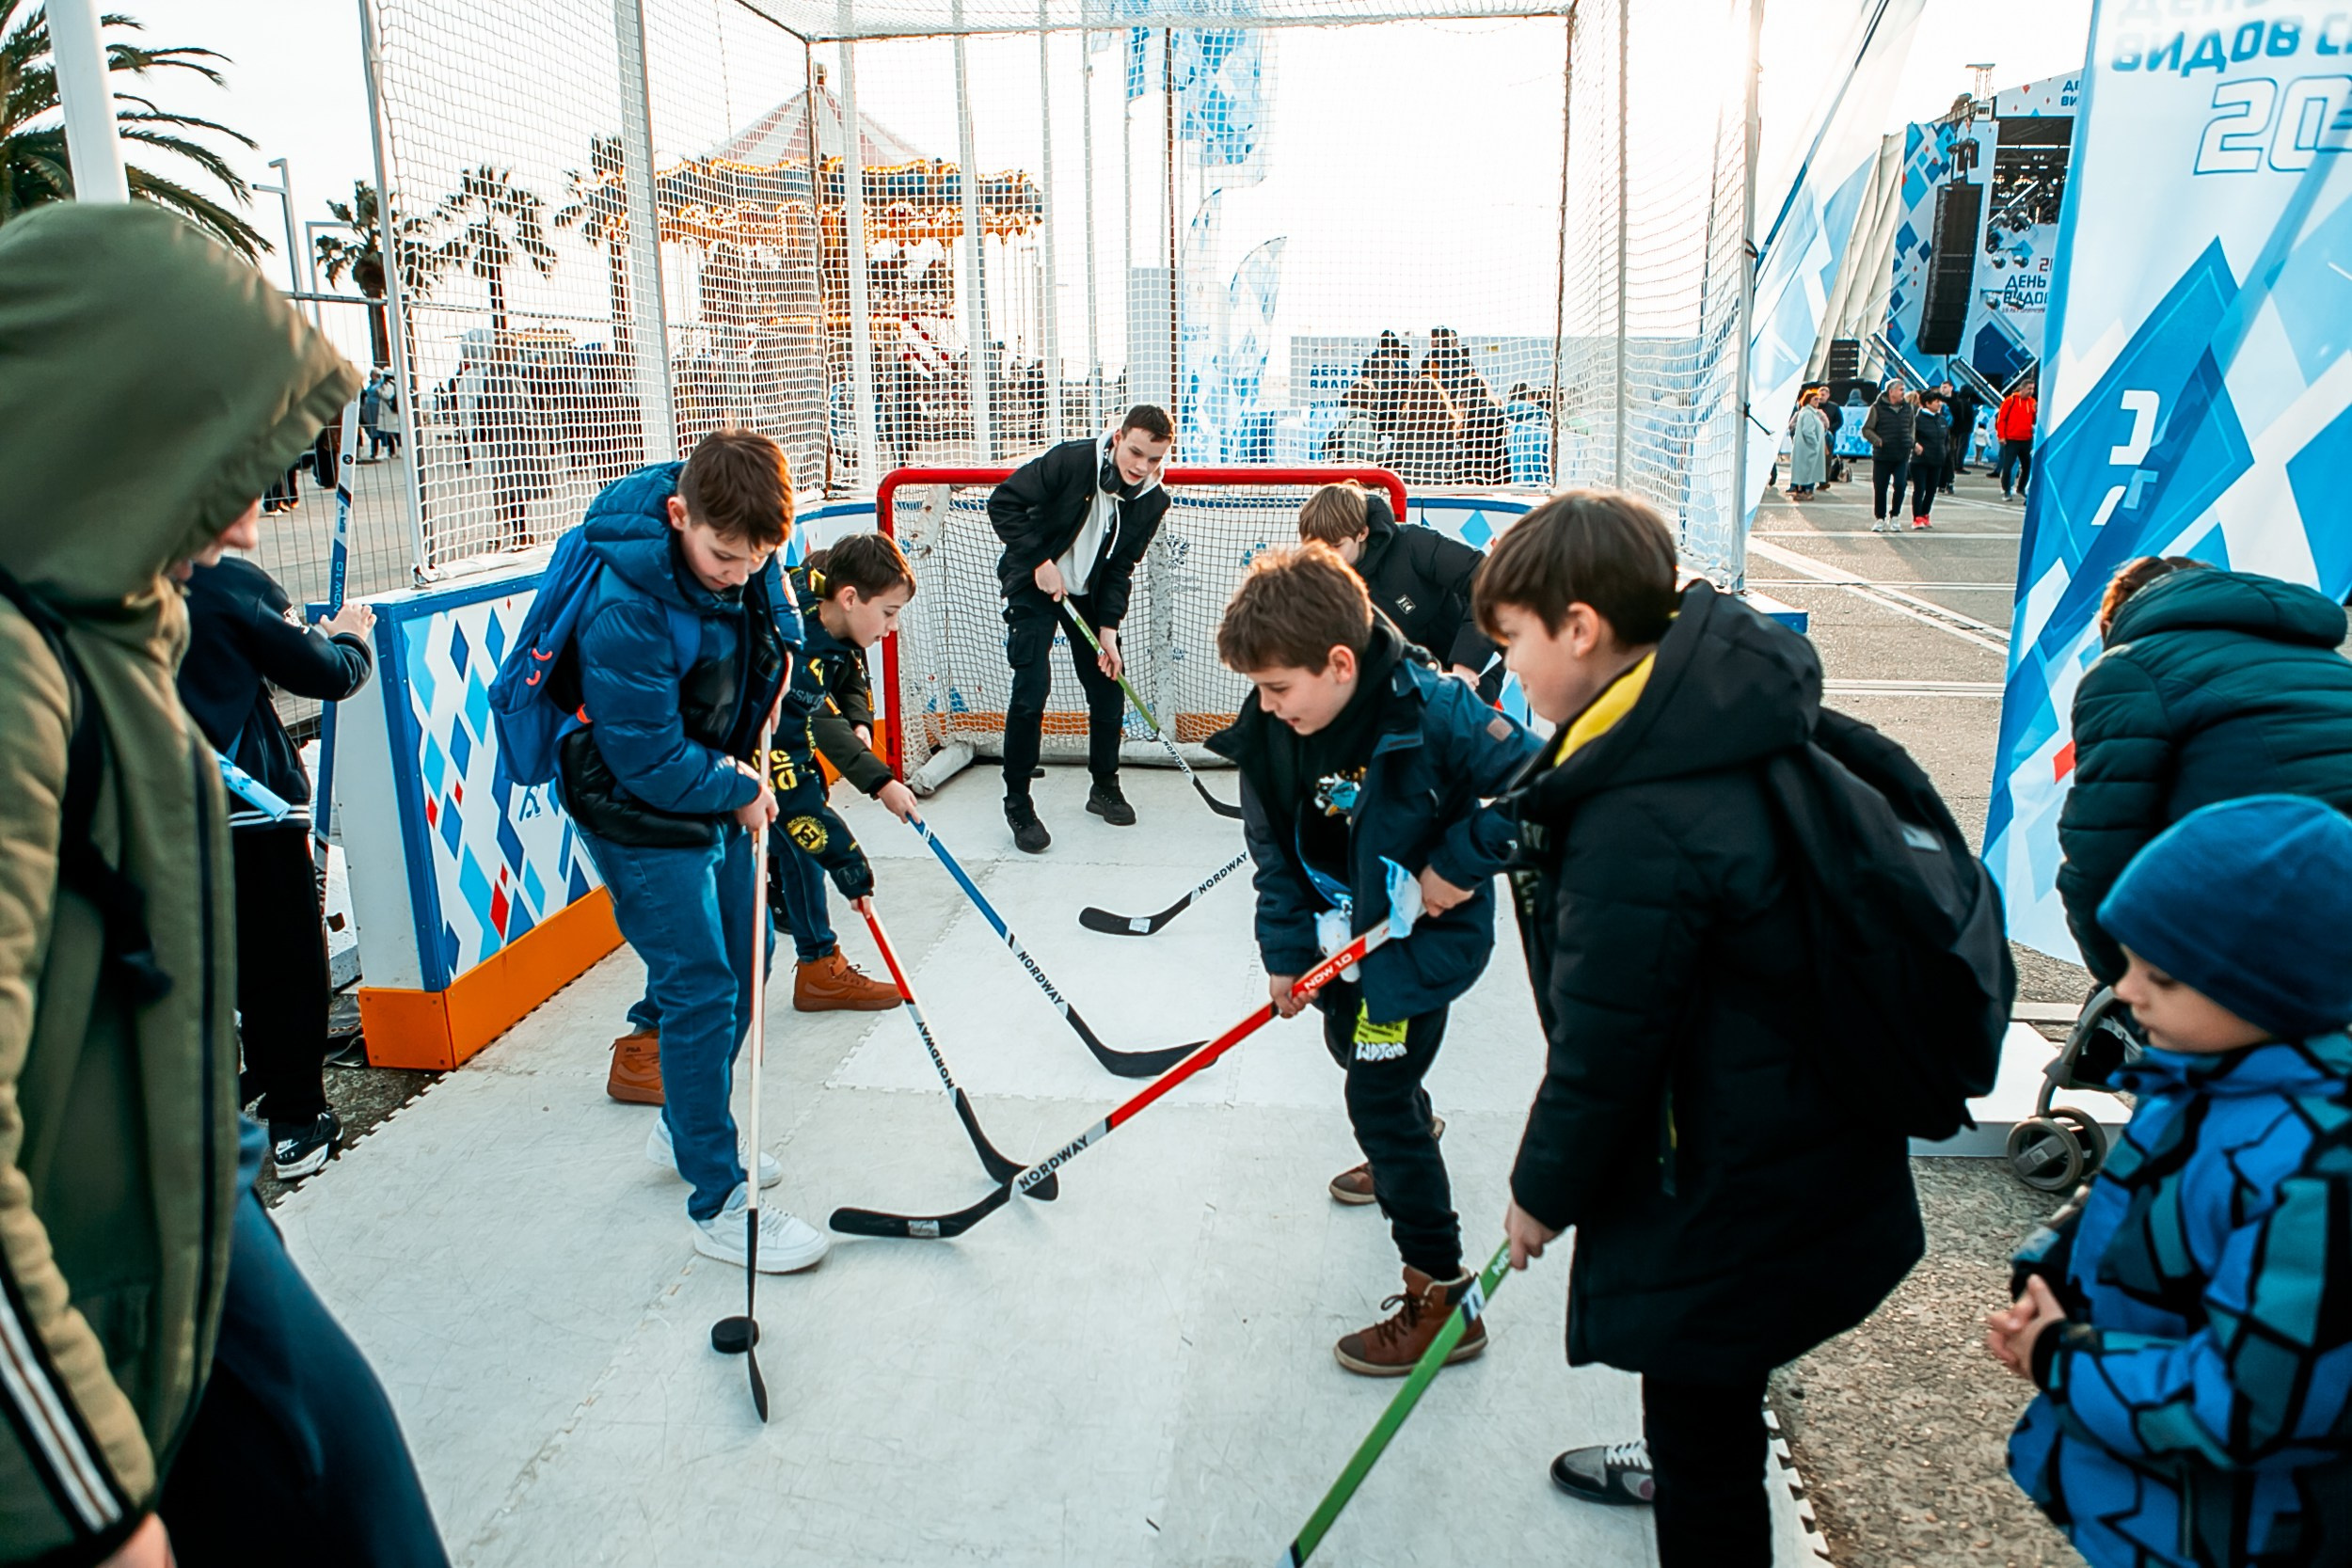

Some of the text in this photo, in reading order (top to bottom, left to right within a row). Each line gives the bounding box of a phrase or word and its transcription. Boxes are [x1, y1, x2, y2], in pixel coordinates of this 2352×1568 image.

[2111, 16, 2304, 78] ВИДОВ
[2003, 292, 2048, 306] ВИДО
[2005, 275, 2046, 292] ДЕНЬ
[1163, 740, 1190, 774] NORDWAY
[1198, 850, 1248, 895] NORDWAY
[1017, 950, 1064, 1005] NORDWAY
[916, 1022, 955, 1090] NORDWAY
[1018, 1134, 1089, 1190] NORDWAY
